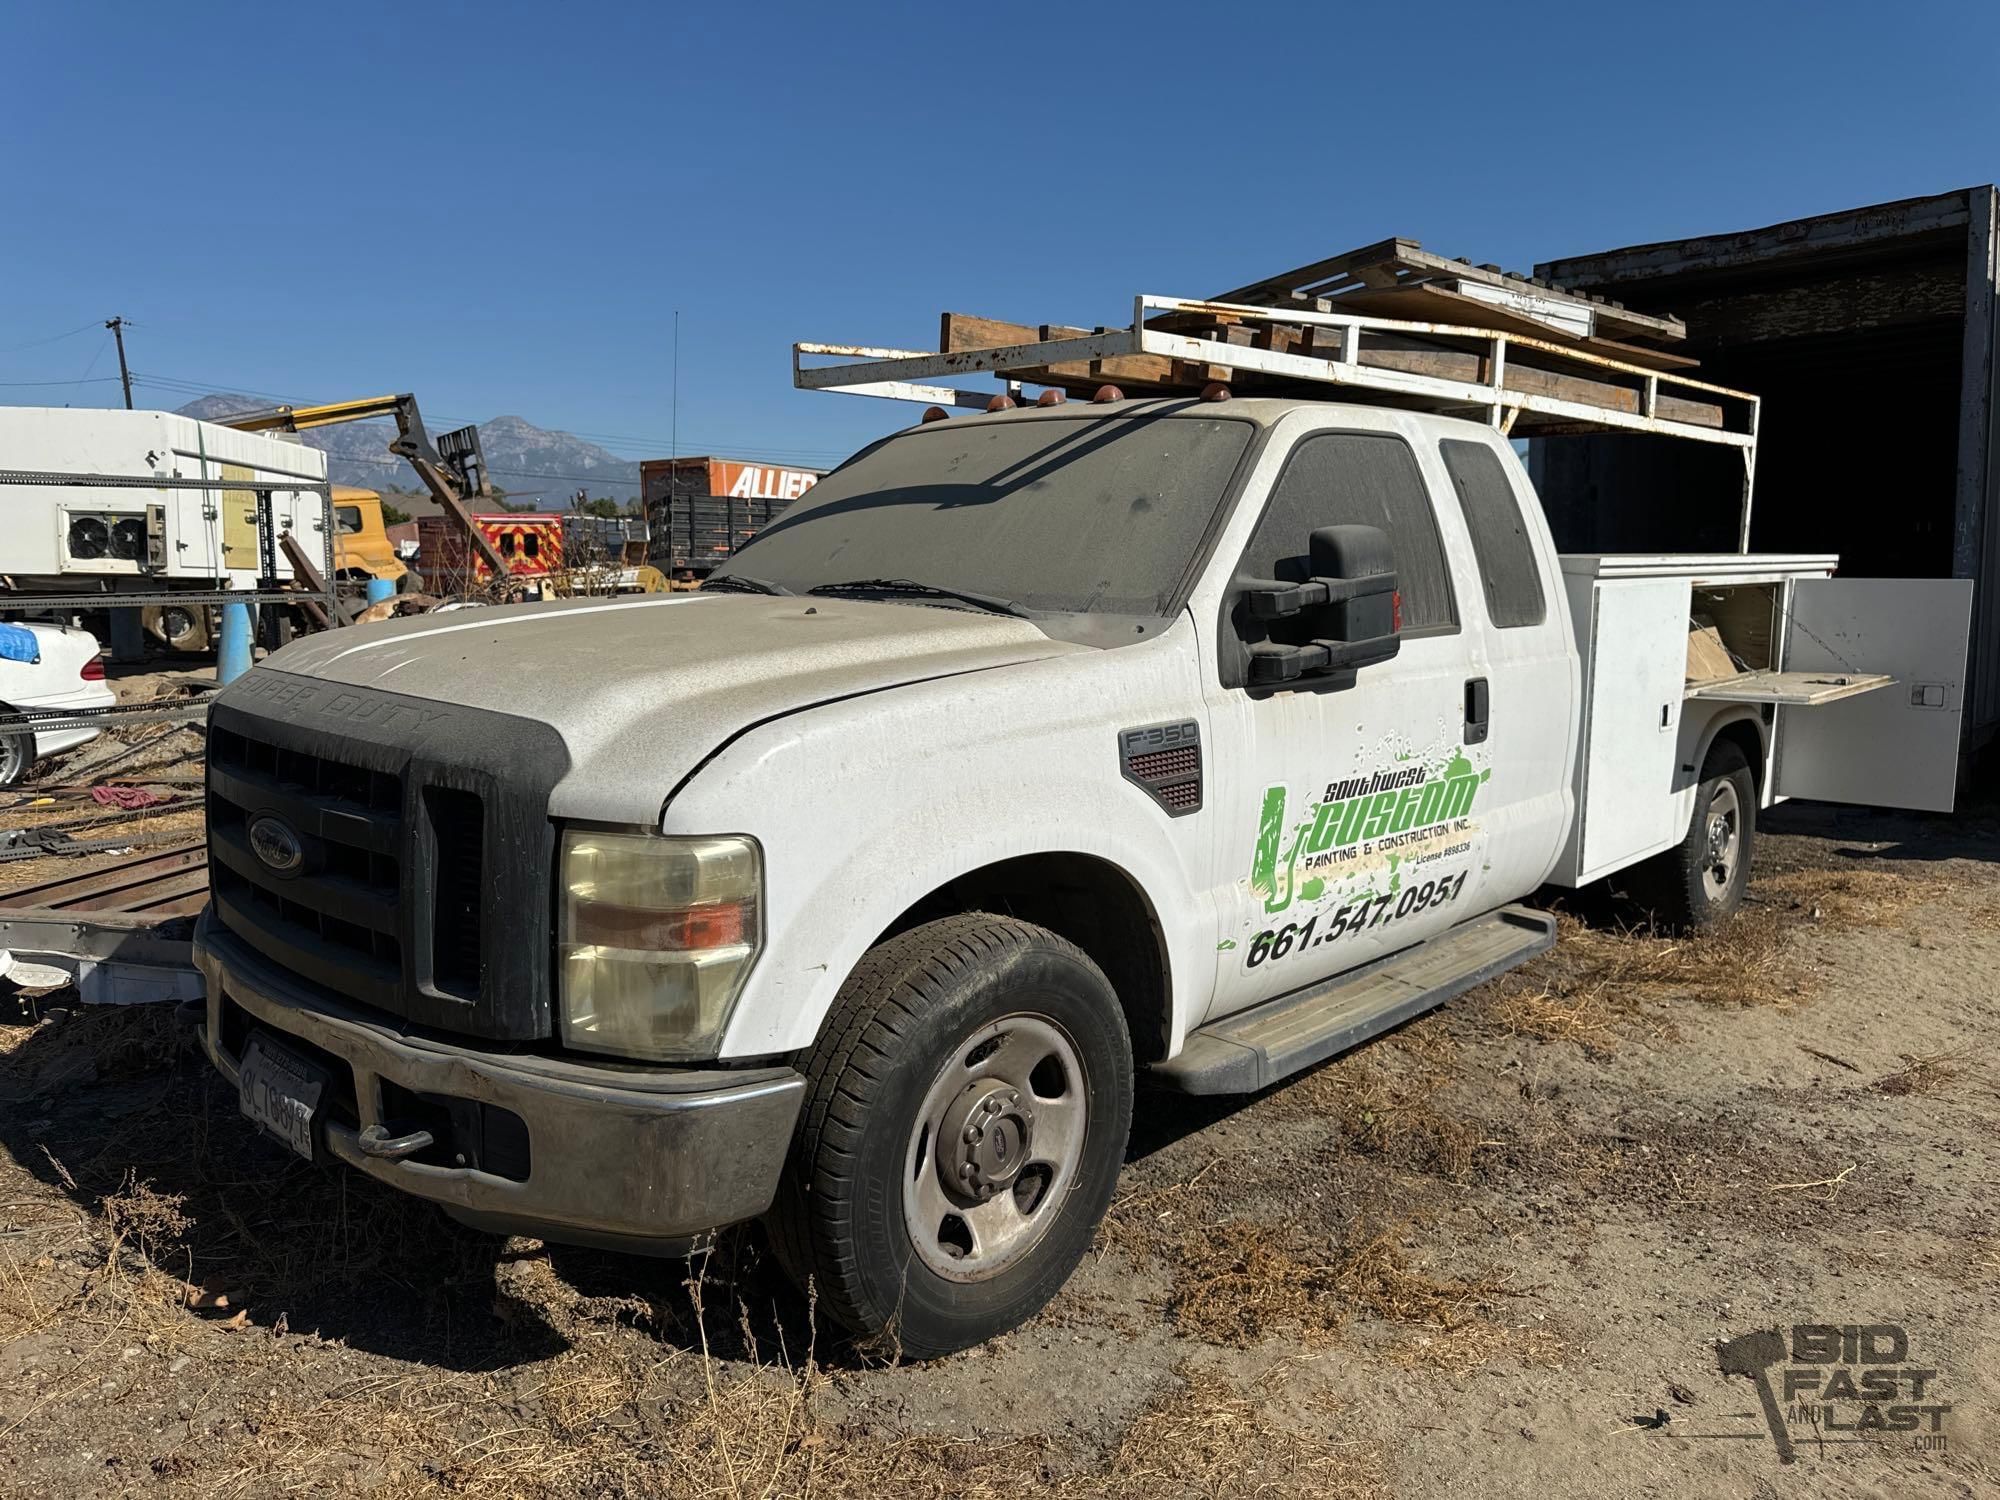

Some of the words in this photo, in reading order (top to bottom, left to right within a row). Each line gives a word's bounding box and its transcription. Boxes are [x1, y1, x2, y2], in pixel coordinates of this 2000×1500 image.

[729, 466, 818, 499] ALLIED
[321, 693, 450, 731] DUTY
[1126, 722, 1197, 748] F-350
[1305, 846, 1357, 871] PAINTING
[1364, 843, 1373, 855] &
[1378, 824, 1449, 853] CONSTRUCTION
[1453, 818, 1472, 832] INC.
[1416, 850, 1442, 865] License
[1246, 870, 1468, 968] 661.547.0951
